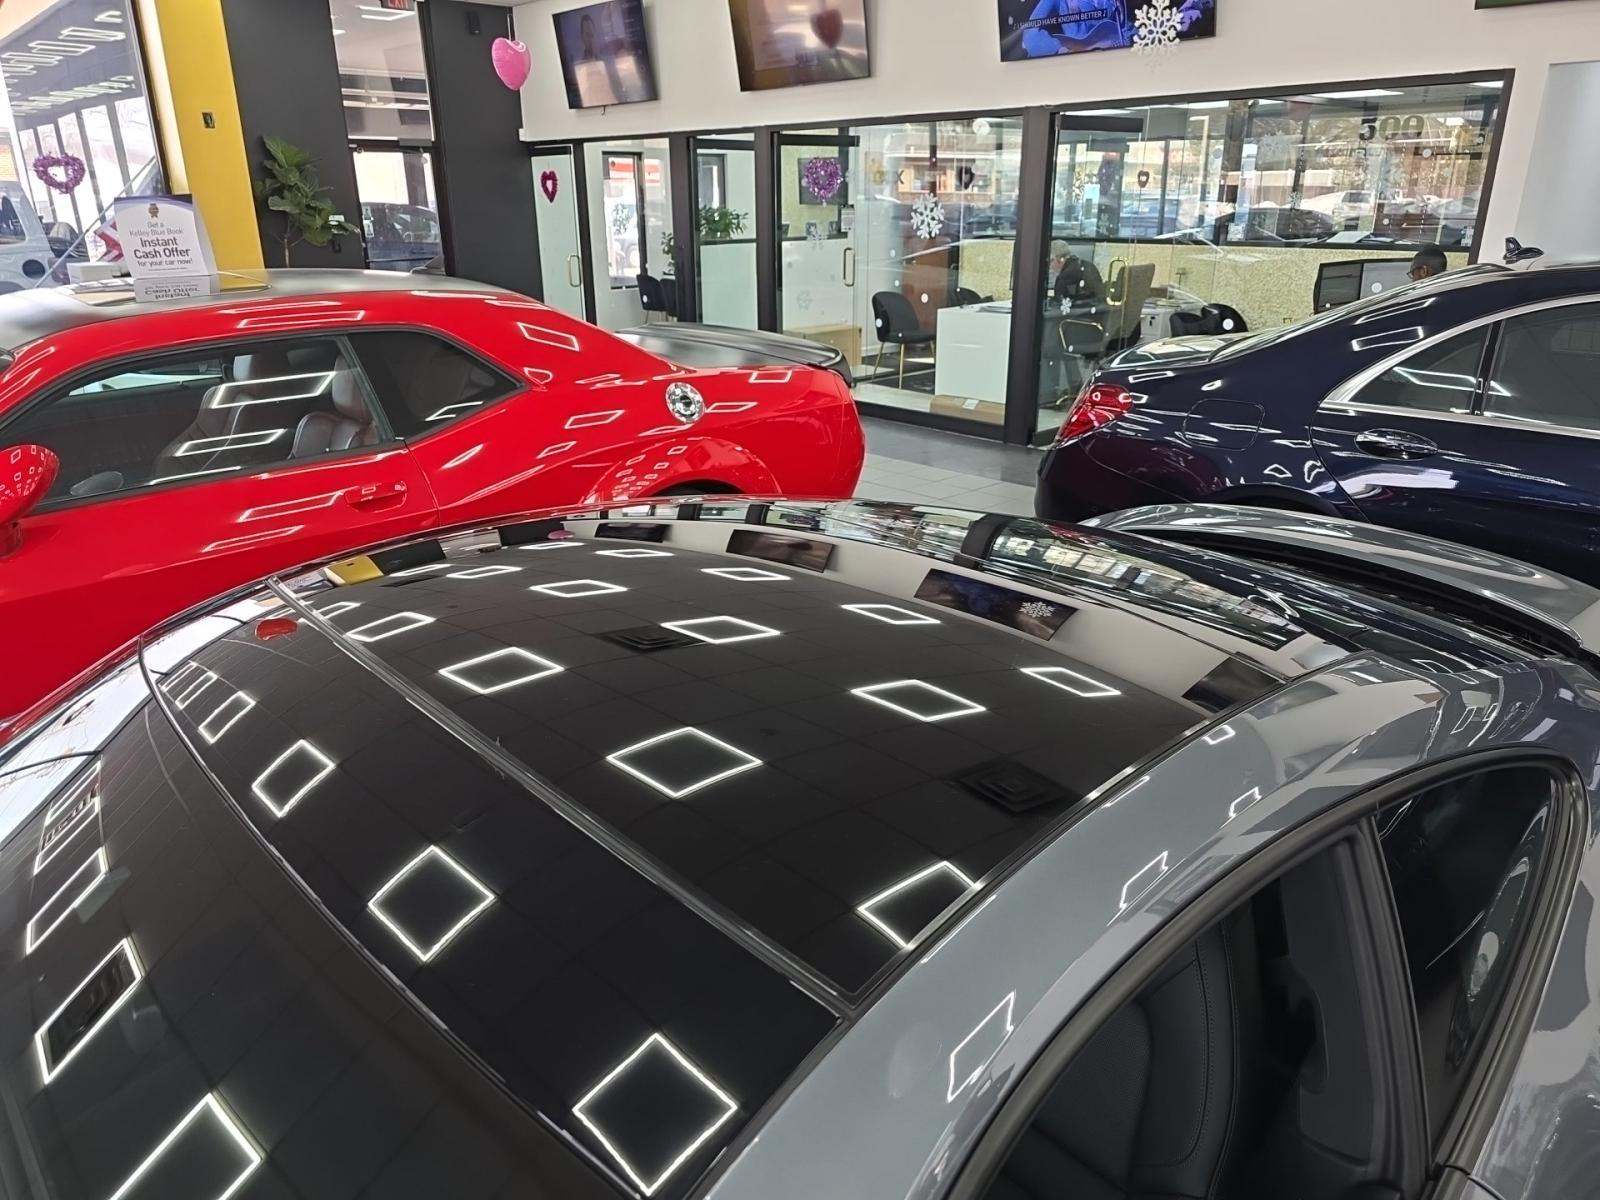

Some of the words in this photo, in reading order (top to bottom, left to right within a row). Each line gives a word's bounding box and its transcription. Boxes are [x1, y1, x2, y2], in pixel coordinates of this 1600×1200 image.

[1020, 20, 1041, 28] SHOULD
[1058, 15, 1080, 23] KNOWN
[1081, 10, 1102, 20] BETTER
[147, 221, 158, 229] Get
[129, 229, 150, 237] Kelley
[140, 237, 179, 248] Instant
[134, 248, 162, 259] Cash
[164, 247, 191, 258] Offer
[148, 259, 163, 267] your
